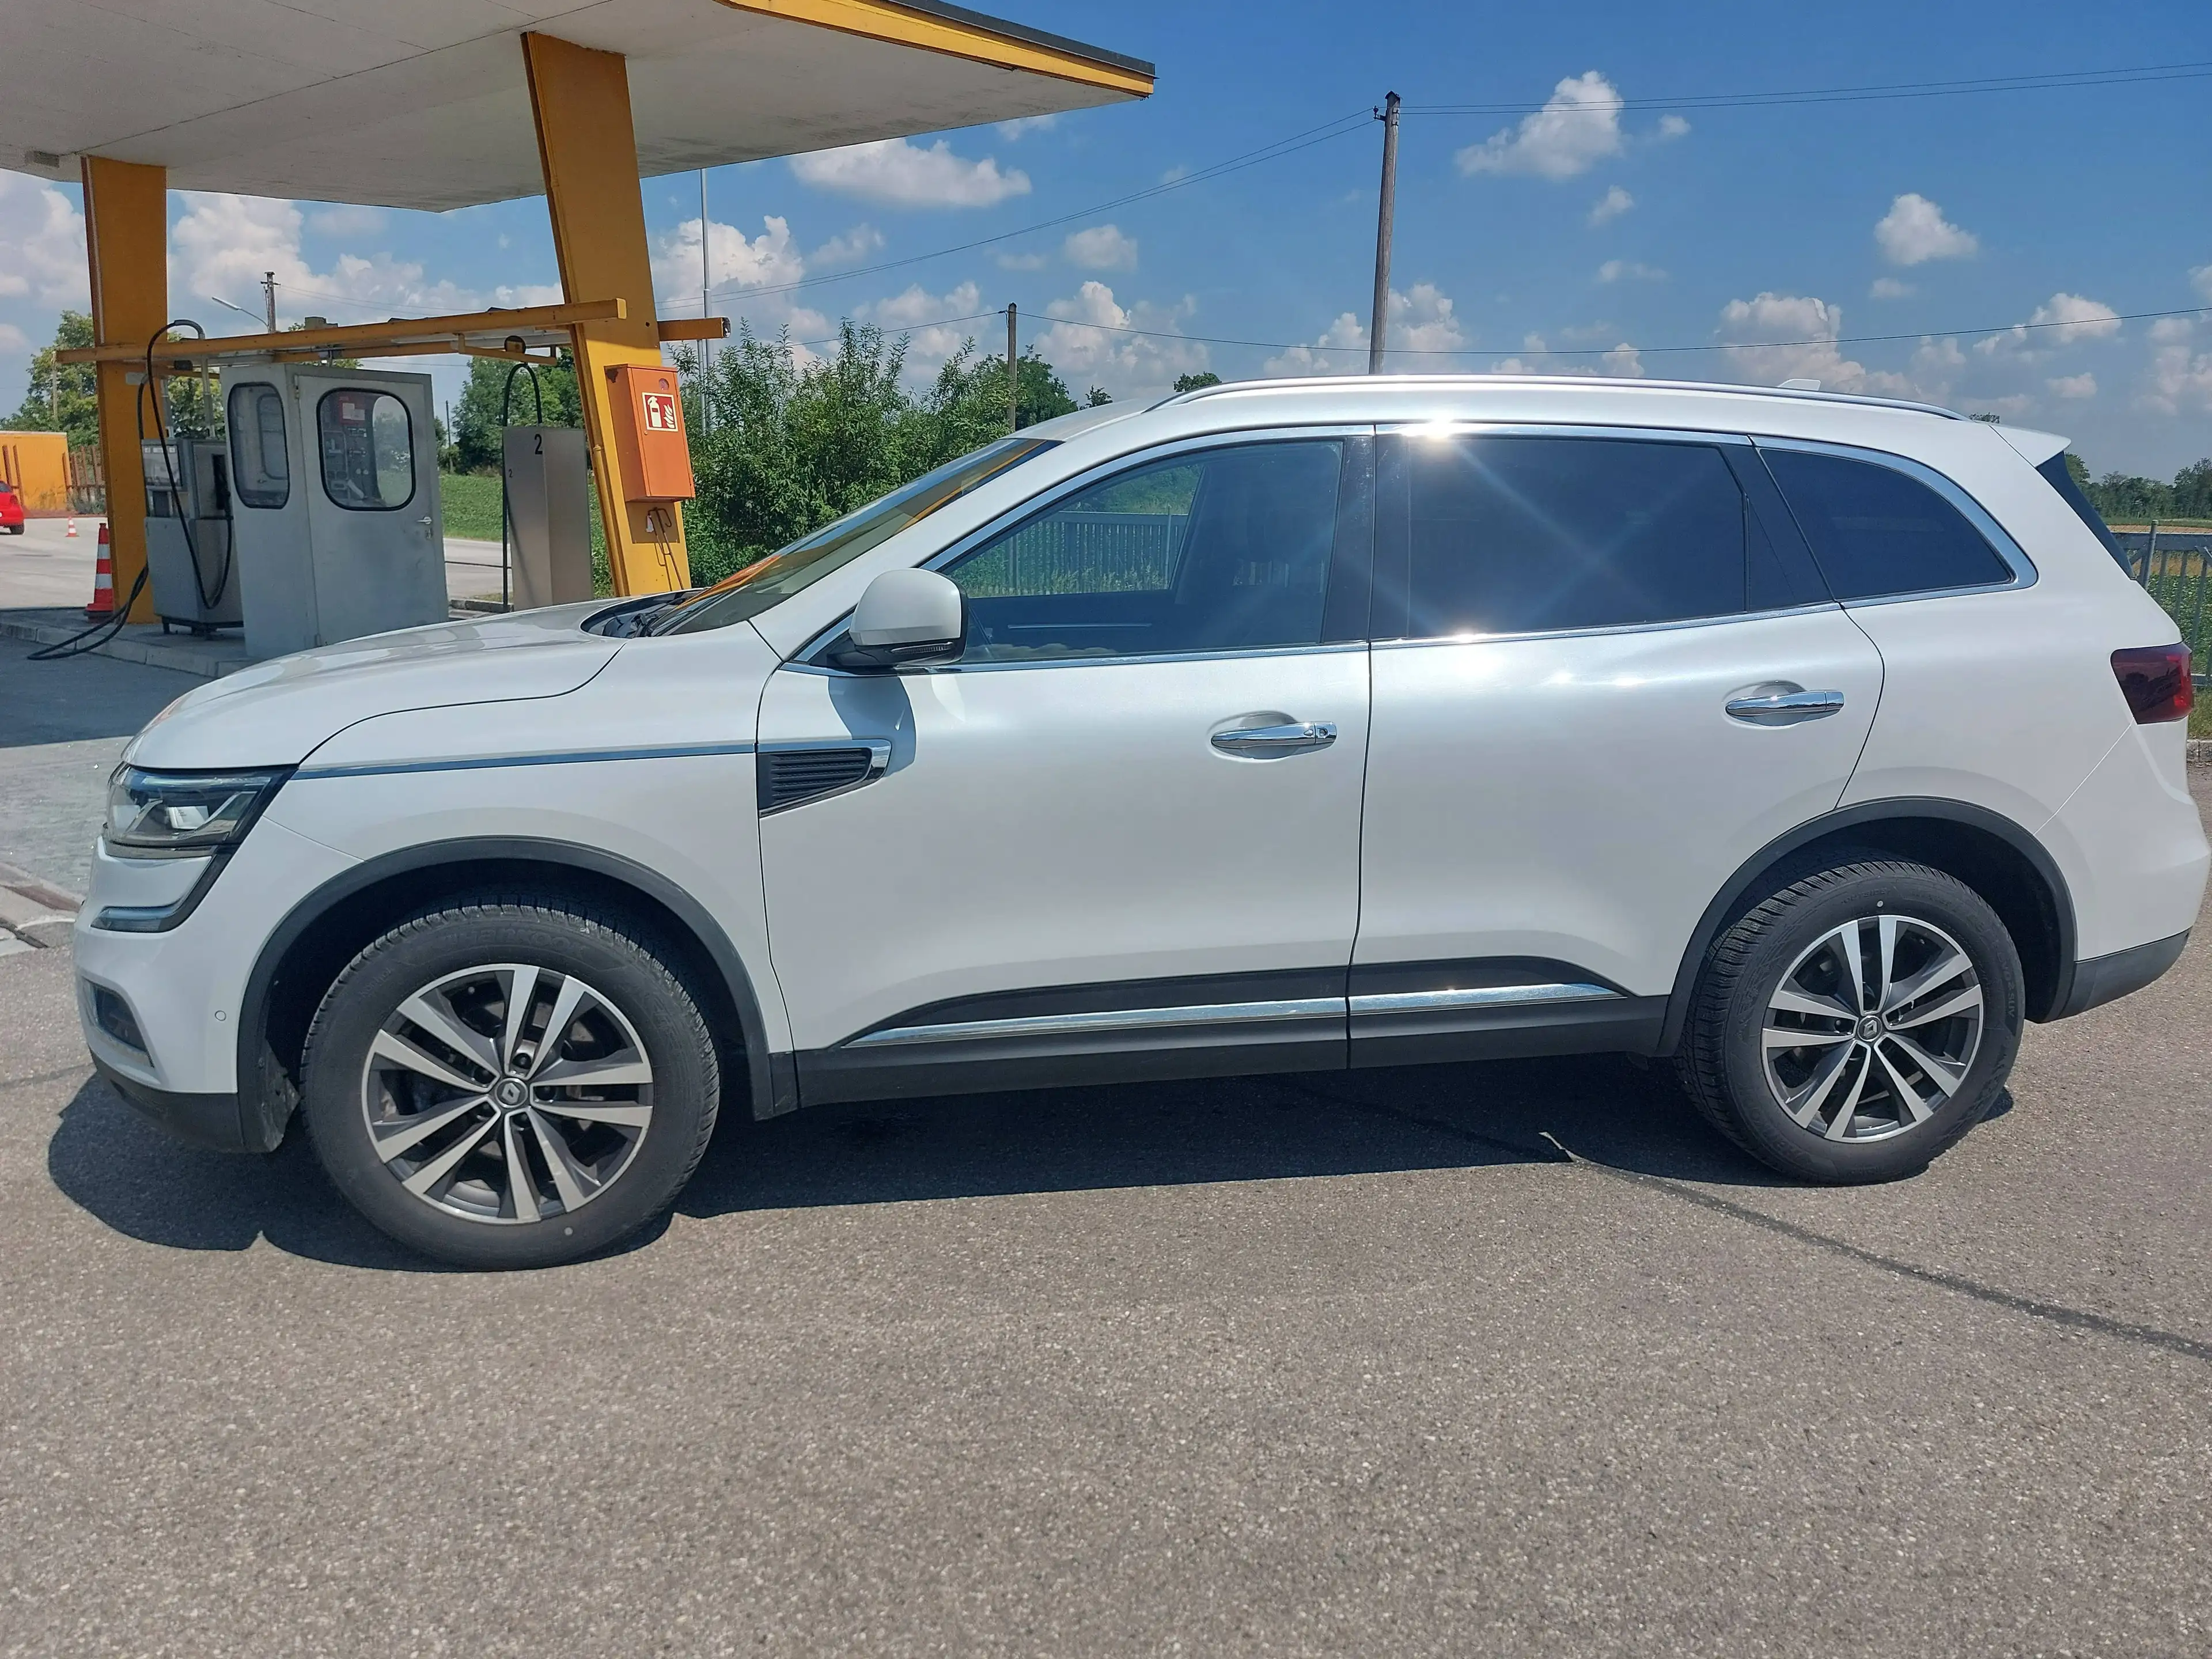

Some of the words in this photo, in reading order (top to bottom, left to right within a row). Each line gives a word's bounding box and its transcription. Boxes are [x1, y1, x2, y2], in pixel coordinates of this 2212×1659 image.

[535, 434, 543, 454] 2
[509, 469, 513, 478] 2
[2008, 991, 2016, 1018] SUV
